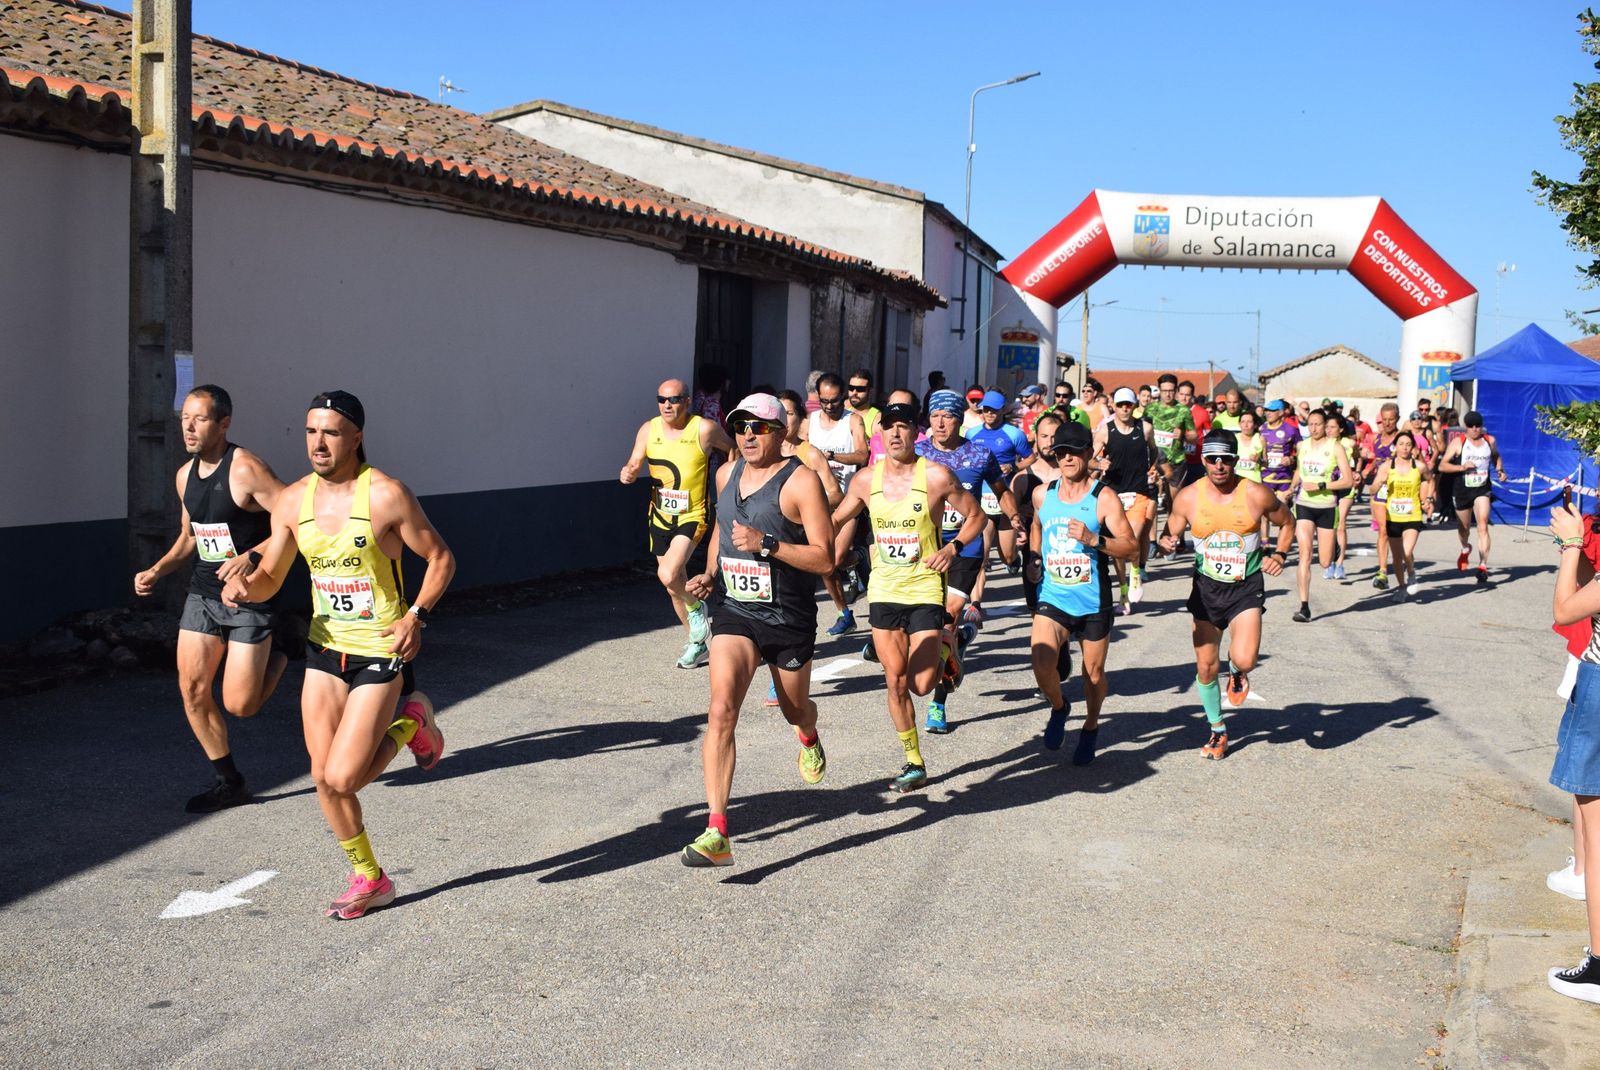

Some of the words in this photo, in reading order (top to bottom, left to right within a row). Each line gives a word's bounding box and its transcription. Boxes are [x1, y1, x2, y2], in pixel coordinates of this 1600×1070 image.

[1185, 206, 1313, 231] Diputación
[1182, 239, 1203, 255] de
[1212, 236, 1336, 258] Salamanca
[1024, 266, 1048, 287] CON
[1046, 256, 1061, 272] EL
[1058, 225, 1103, 263] DEPORTE
[1373, 229, 1398, 253] CON
[1393, 248, 1448, 299] NUESTROS
[1363, 244, 1431, 307] DEPORTISTAS
[664, 498, 678, 509] 20
[1395, 504, 1406, 512] 59
[203, 538, 219, 553] 91
[888, 545, 906, 558] 24
[1047, 556, 1090, 566] bedunia
[1204, 551, 1245, 565] bedunia
[1055, 566, 1081, 579] 129
[1215, 562, 1232, 575] 92
[313, 578, 371, 594] bedunia
[731, 574, 760, 592] 135
[329, 594, 354, 612] 25
